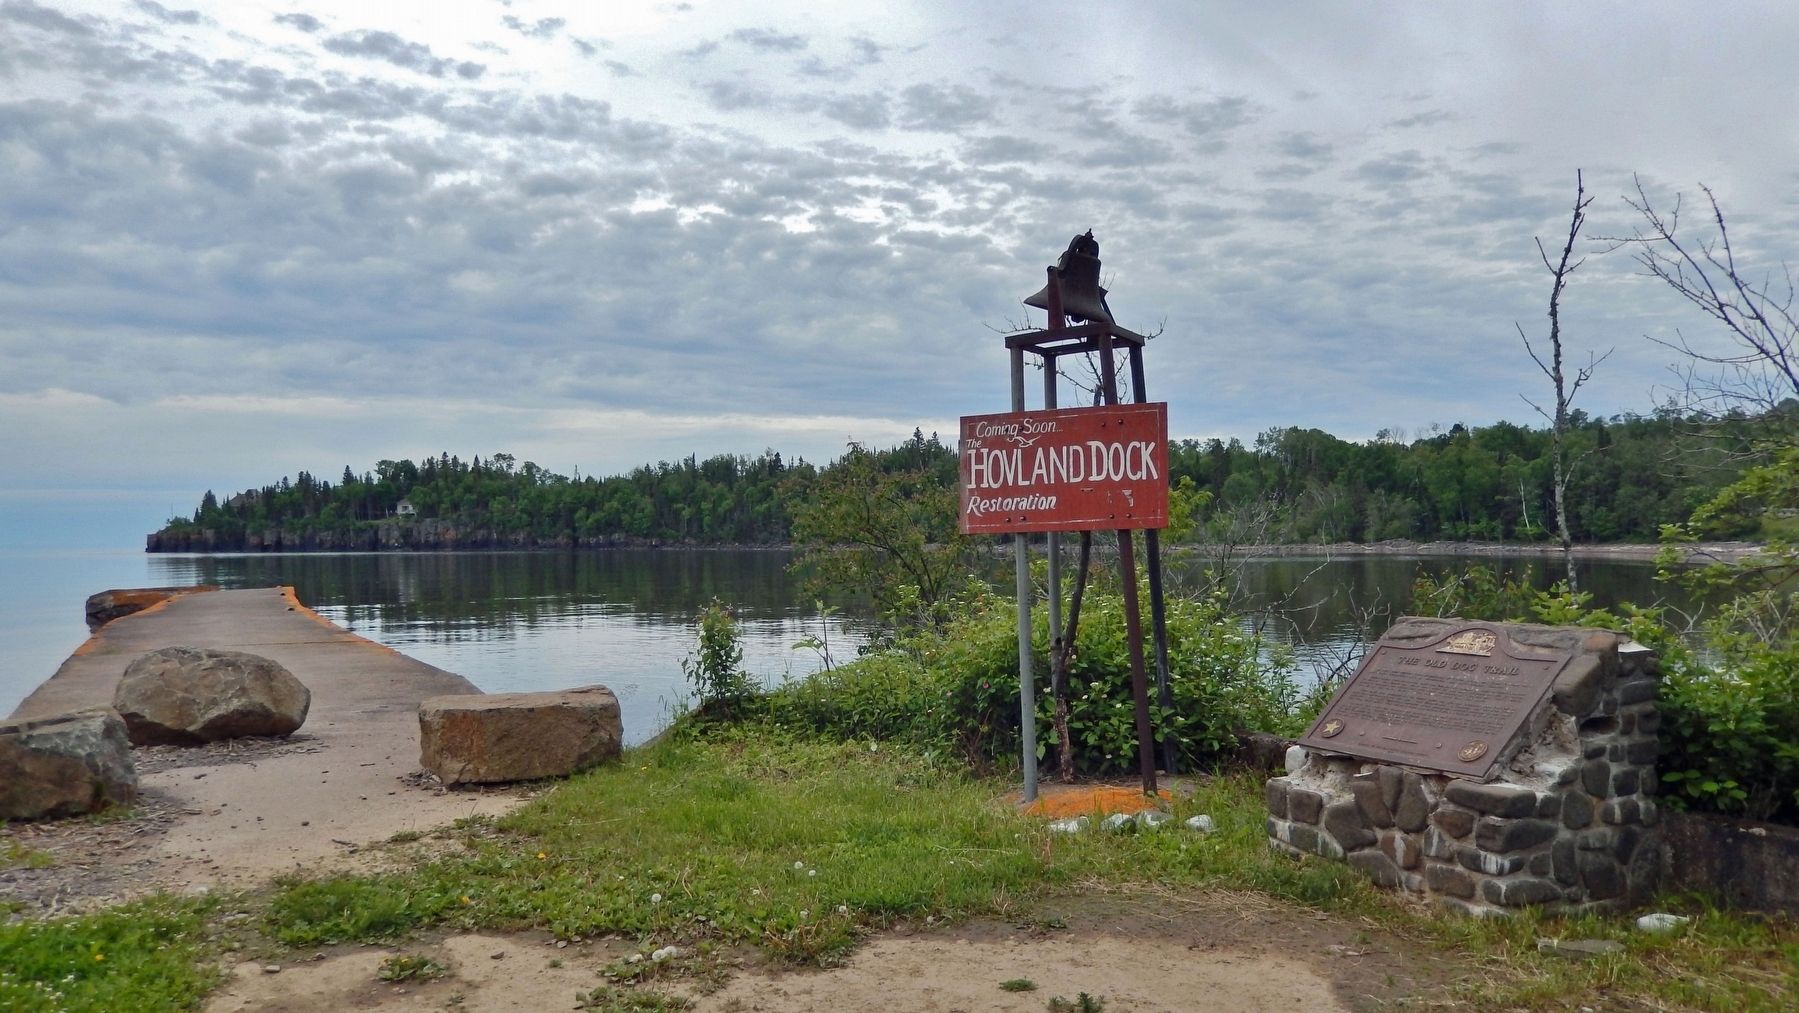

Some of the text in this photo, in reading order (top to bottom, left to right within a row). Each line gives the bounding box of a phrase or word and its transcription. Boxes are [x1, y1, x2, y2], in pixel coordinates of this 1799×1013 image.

[976, 421, 1019, 438] Coming
[966, 438, 982, 448] The
[967, 441, 1158, 489] HOVLAND DOCK
[966, 493, 1057, 517] Restoration
[1397, 656, 1519, 676] THE OLD DOG TRAIL
